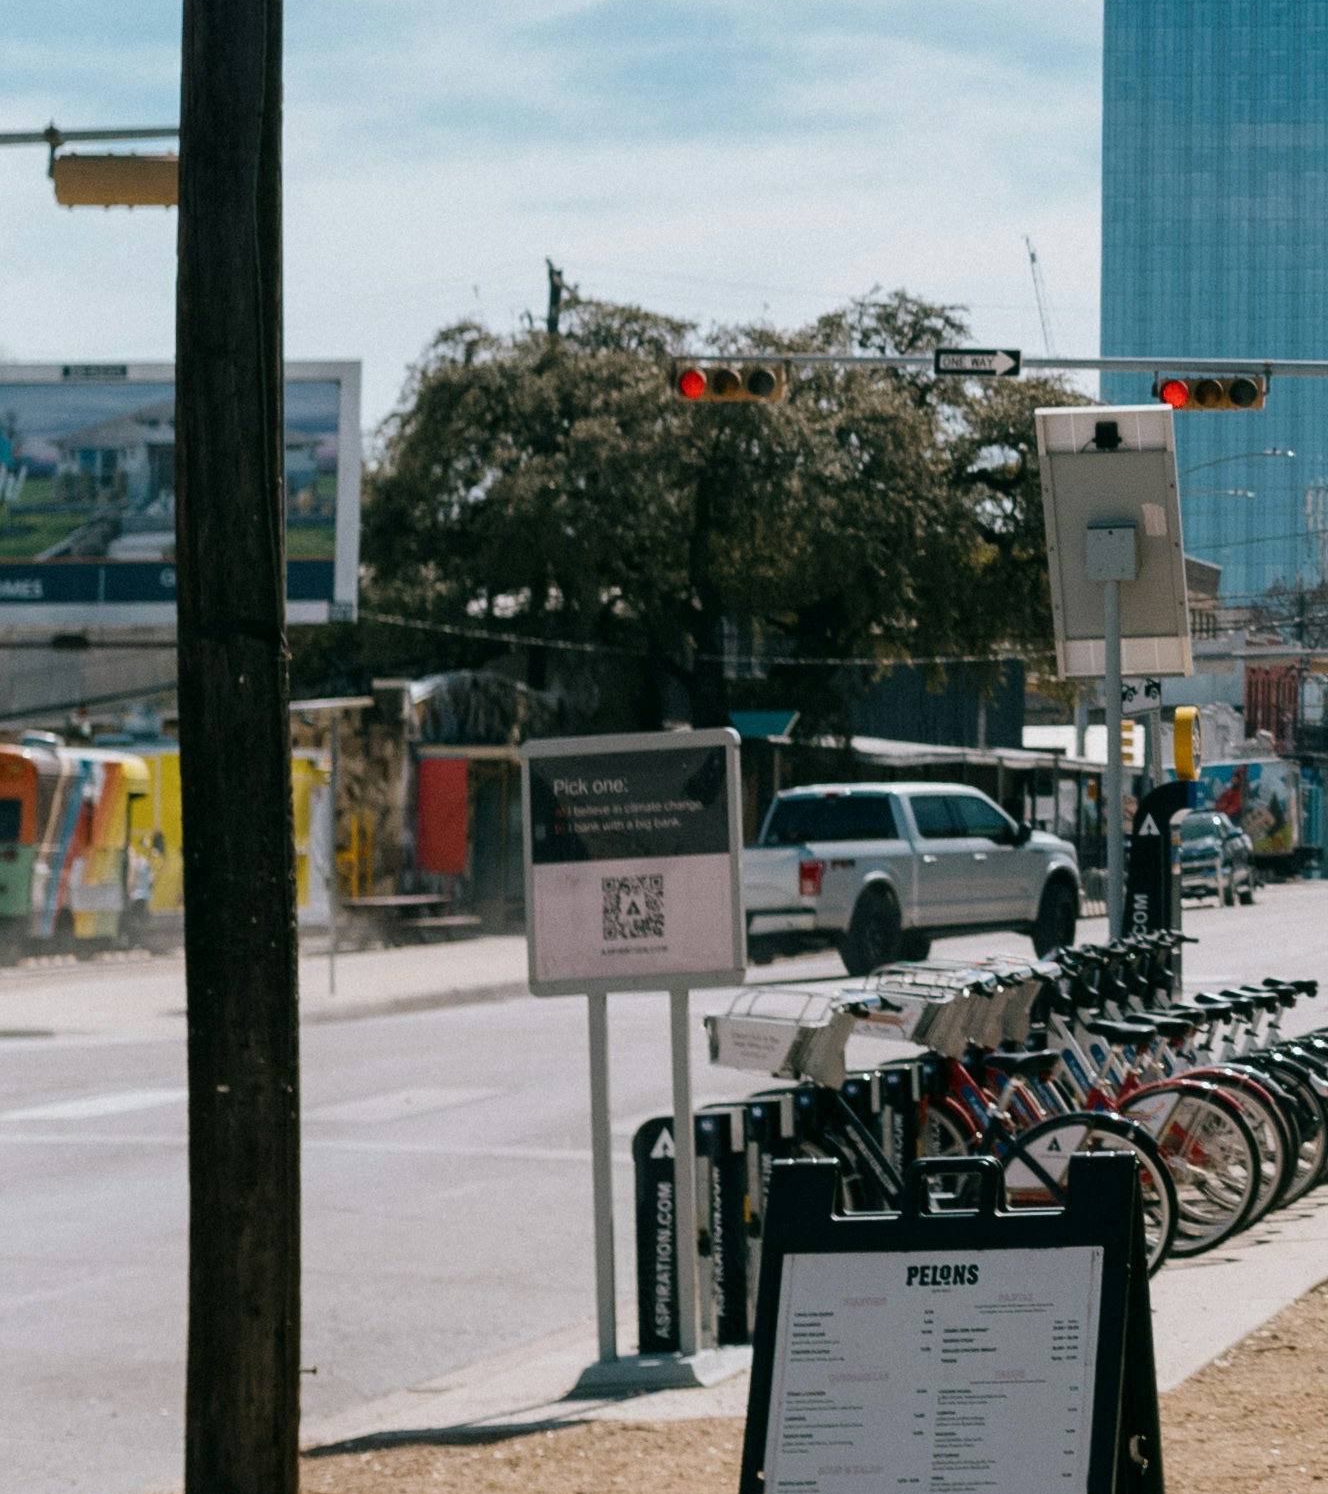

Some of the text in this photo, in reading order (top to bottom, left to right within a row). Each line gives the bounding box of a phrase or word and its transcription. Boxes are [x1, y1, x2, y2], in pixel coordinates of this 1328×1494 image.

[970, 357, 993, 367] WAY
[553, 777, 629, 796] Pick one:
[573, 805, 610, 817] believe
[574, 821, 599, 833] bank
[602, 820, 624, 831] with
[626, 821, 633, 830] a
[634, 818, 652, 832] big
[655, 1180, 673, 1340] ASPIRATION.COM
[905, 1264, 979, 1286] PELONS
